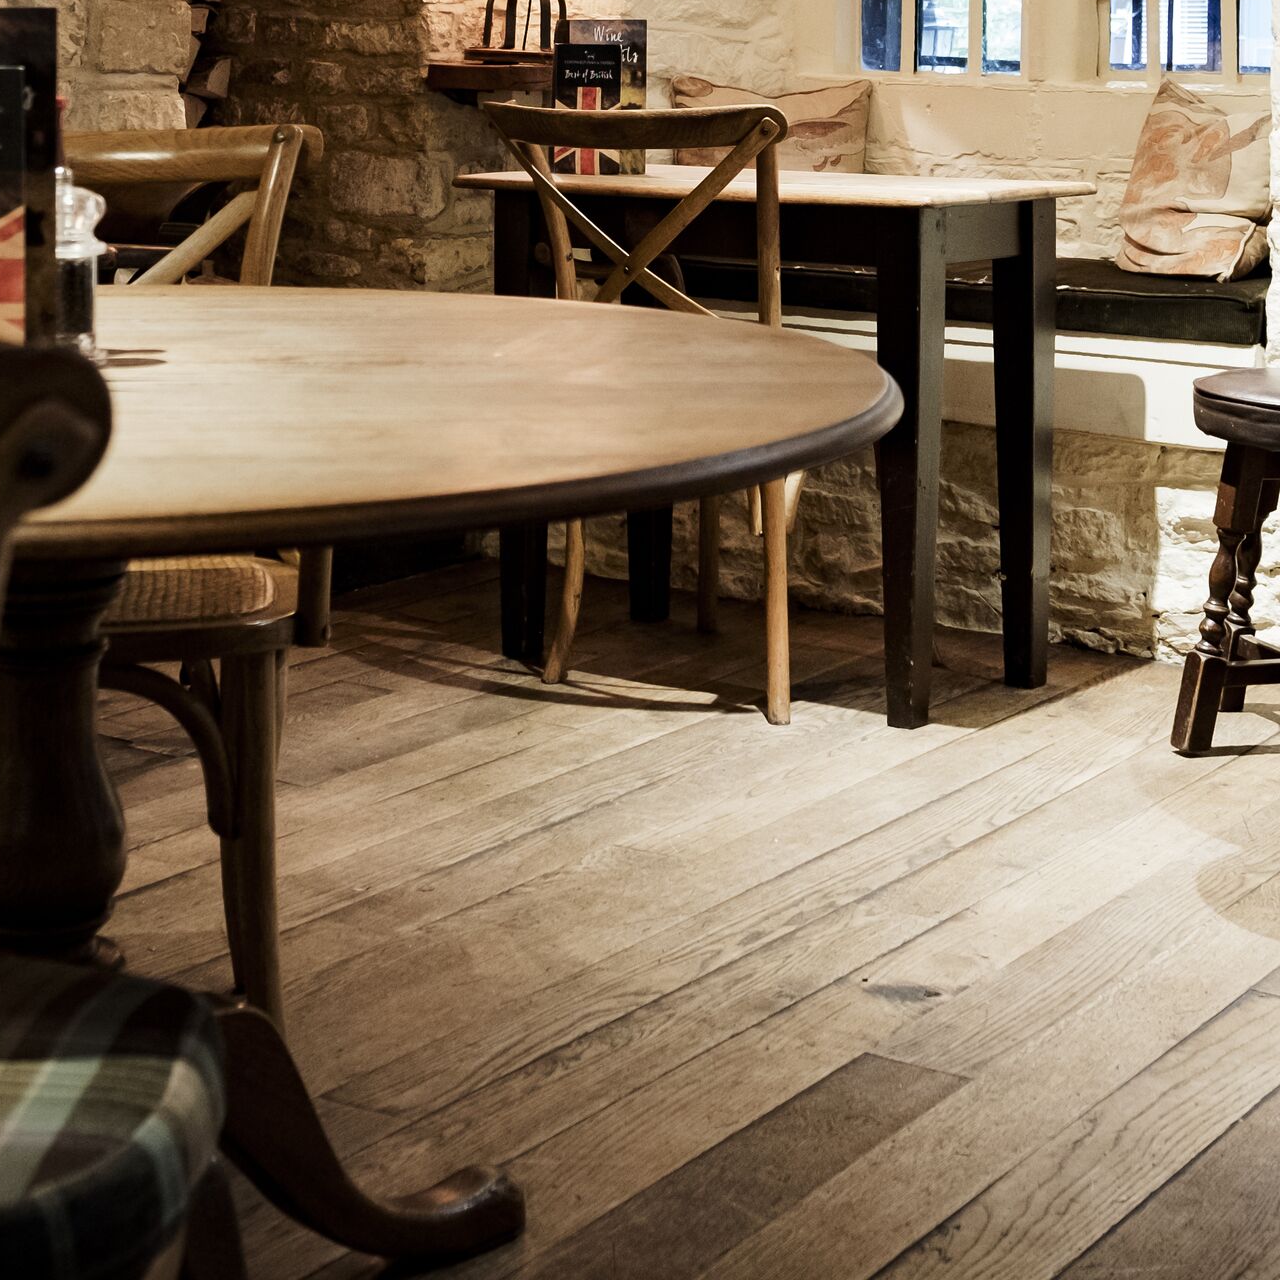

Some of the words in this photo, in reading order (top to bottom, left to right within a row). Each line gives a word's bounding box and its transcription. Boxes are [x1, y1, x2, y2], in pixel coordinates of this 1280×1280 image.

[594, 25, 624, 43] Wine
[564, 69, 580, 79] Best
[582, 68, 589, 84] of
[589, 69, 613, 80] British
